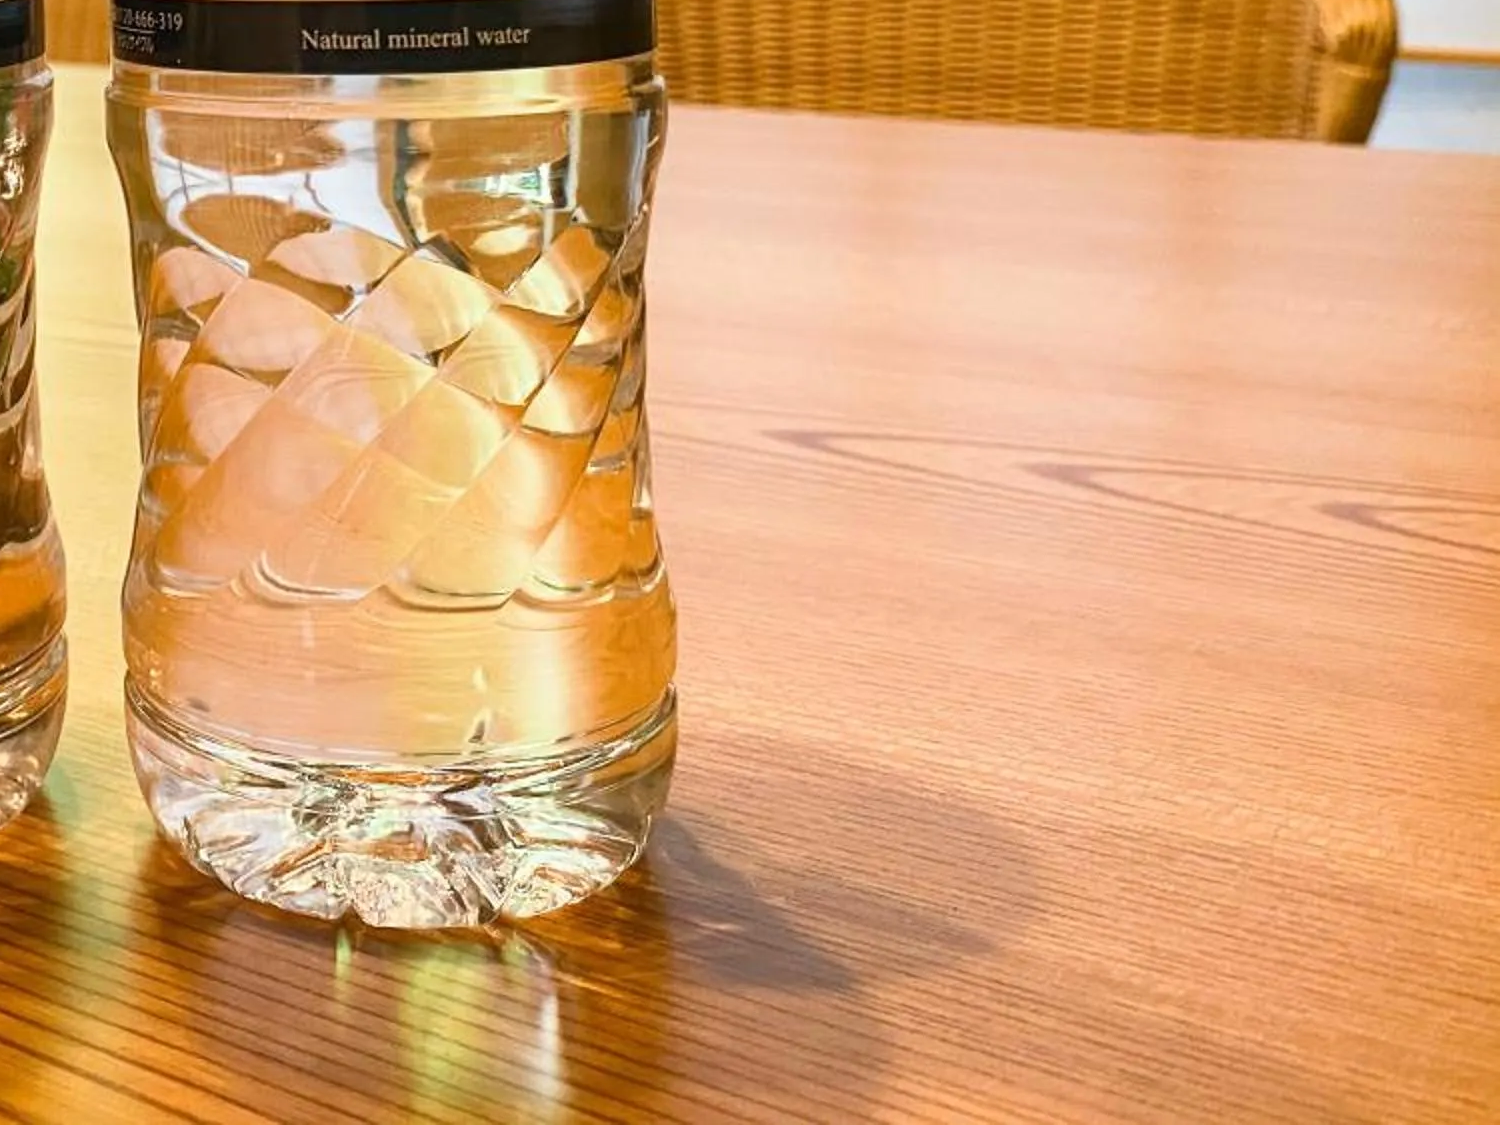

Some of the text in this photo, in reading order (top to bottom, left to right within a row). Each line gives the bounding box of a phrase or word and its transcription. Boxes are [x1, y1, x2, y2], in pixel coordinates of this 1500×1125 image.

[301, 25, 531, 51] Natural mineral water
